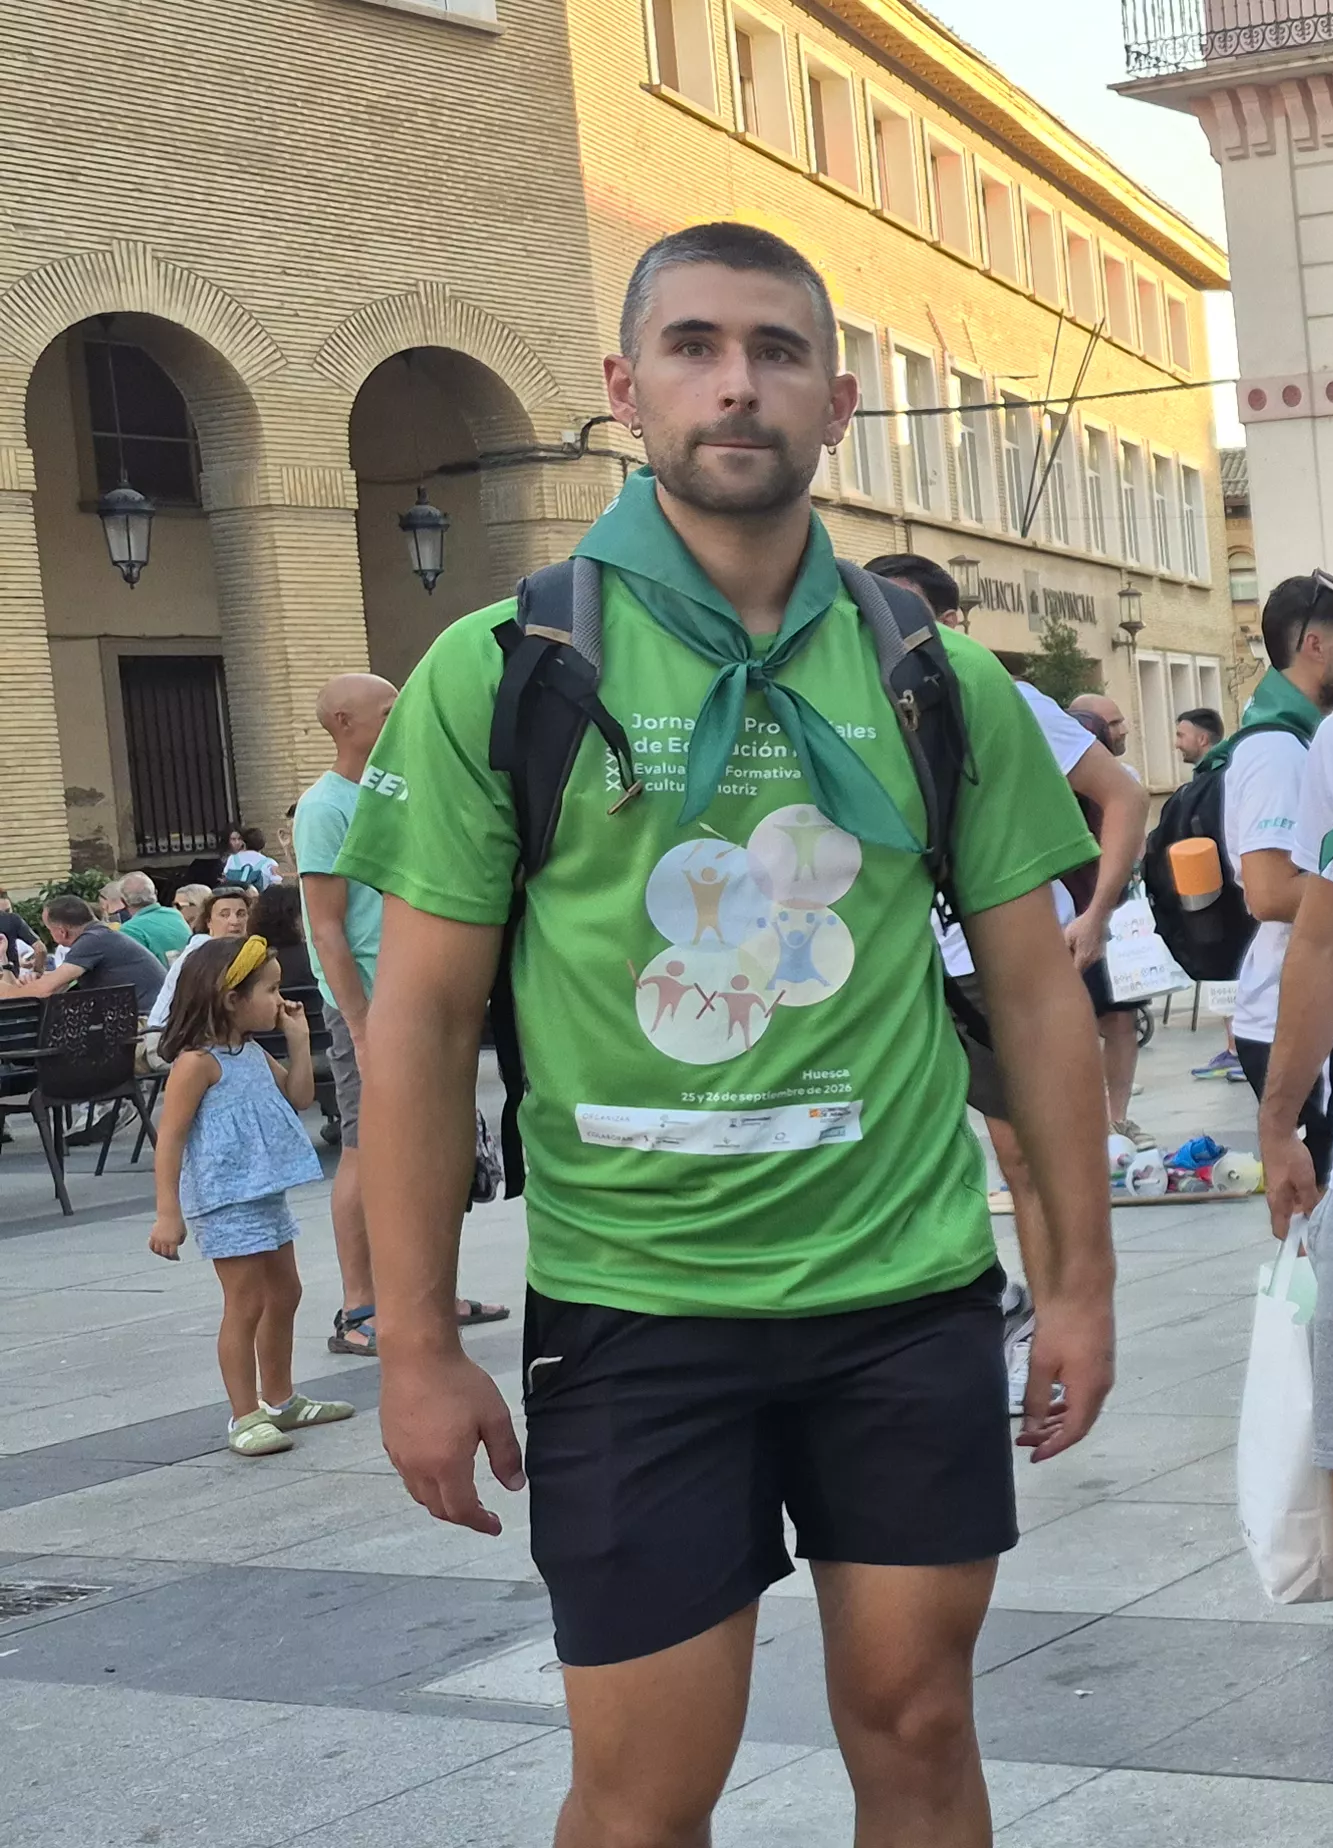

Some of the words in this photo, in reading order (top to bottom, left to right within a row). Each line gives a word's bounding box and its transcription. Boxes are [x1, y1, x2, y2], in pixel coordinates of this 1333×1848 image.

[631, 713, 695, 731] Jorna
[633, 737, 663, 753] de
[633, 762, 687, 776] Evalua
[725, 765, 802, 780] Formativa
[644, 778, 686, 793] cultu
[802, 1068, 850, 1080] Huesca
[681, 1092, 695, 1102] 25
[696, 1093, 704, 1103] y
[706, 1091, 720, 1102] 26
[721, 1091, 736, 1102] de
[738, 1086, 805, 1103] septiembre
[807, 1085, 822, 1095] de
[823, 1082, 853, 1095] 2026
